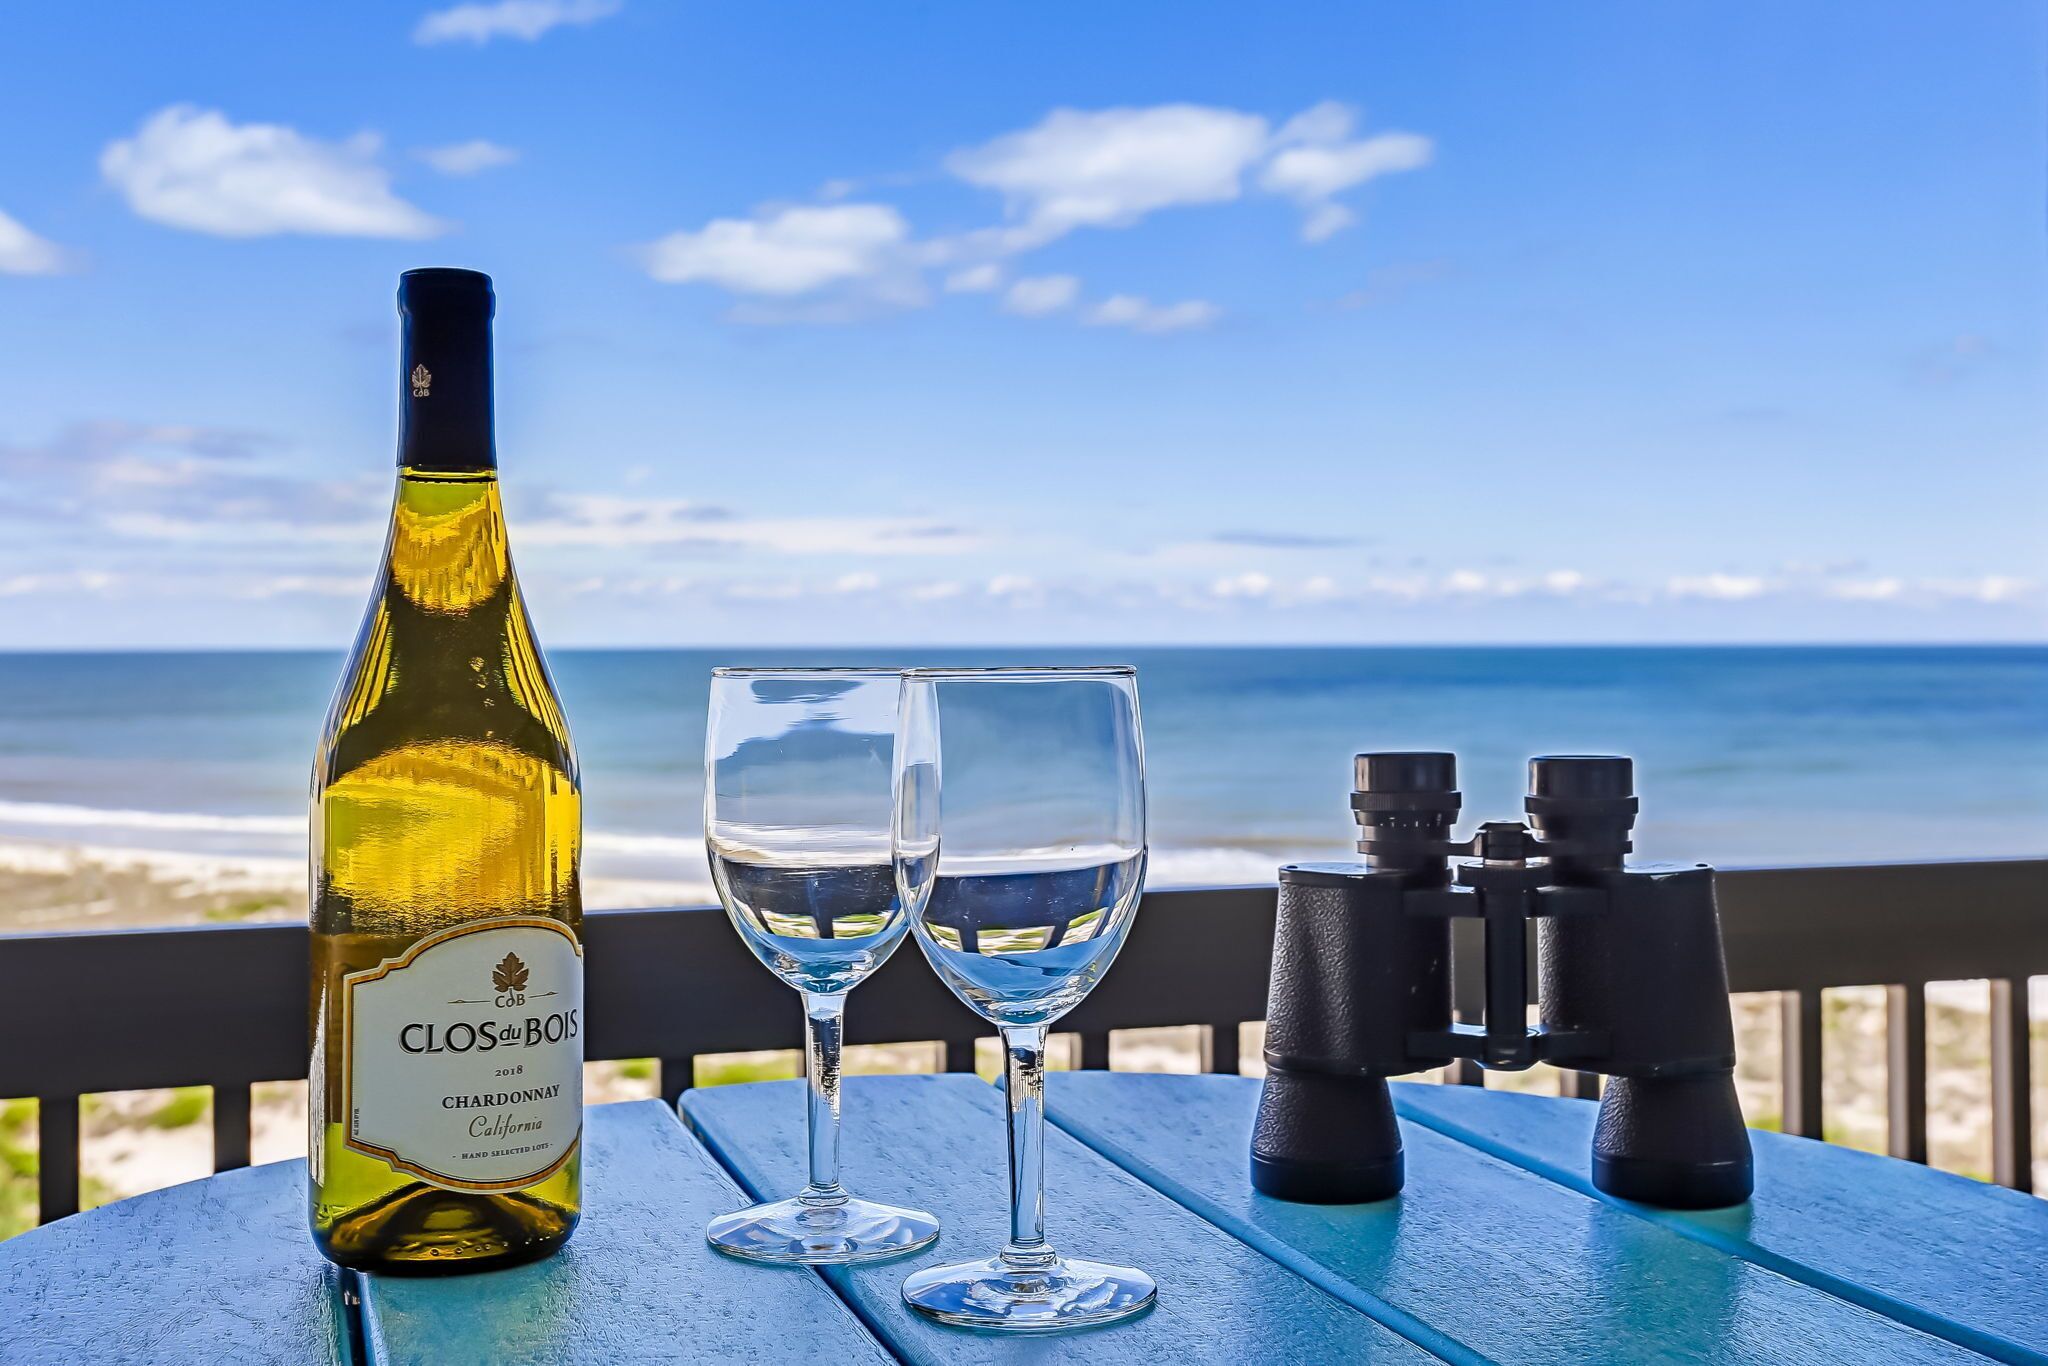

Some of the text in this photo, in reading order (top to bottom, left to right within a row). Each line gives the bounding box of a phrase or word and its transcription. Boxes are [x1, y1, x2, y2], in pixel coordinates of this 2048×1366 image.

[398, 1008, 578, 1055] CLOS du BOIS
[495, 1064, 523, 1077] 2018
[442, 1084, 560, 1109] CHARDONNAY
[468, 1113, 543, 1140] California
[461, 1142, 550, 1160] HAND SELECTED LOTS
